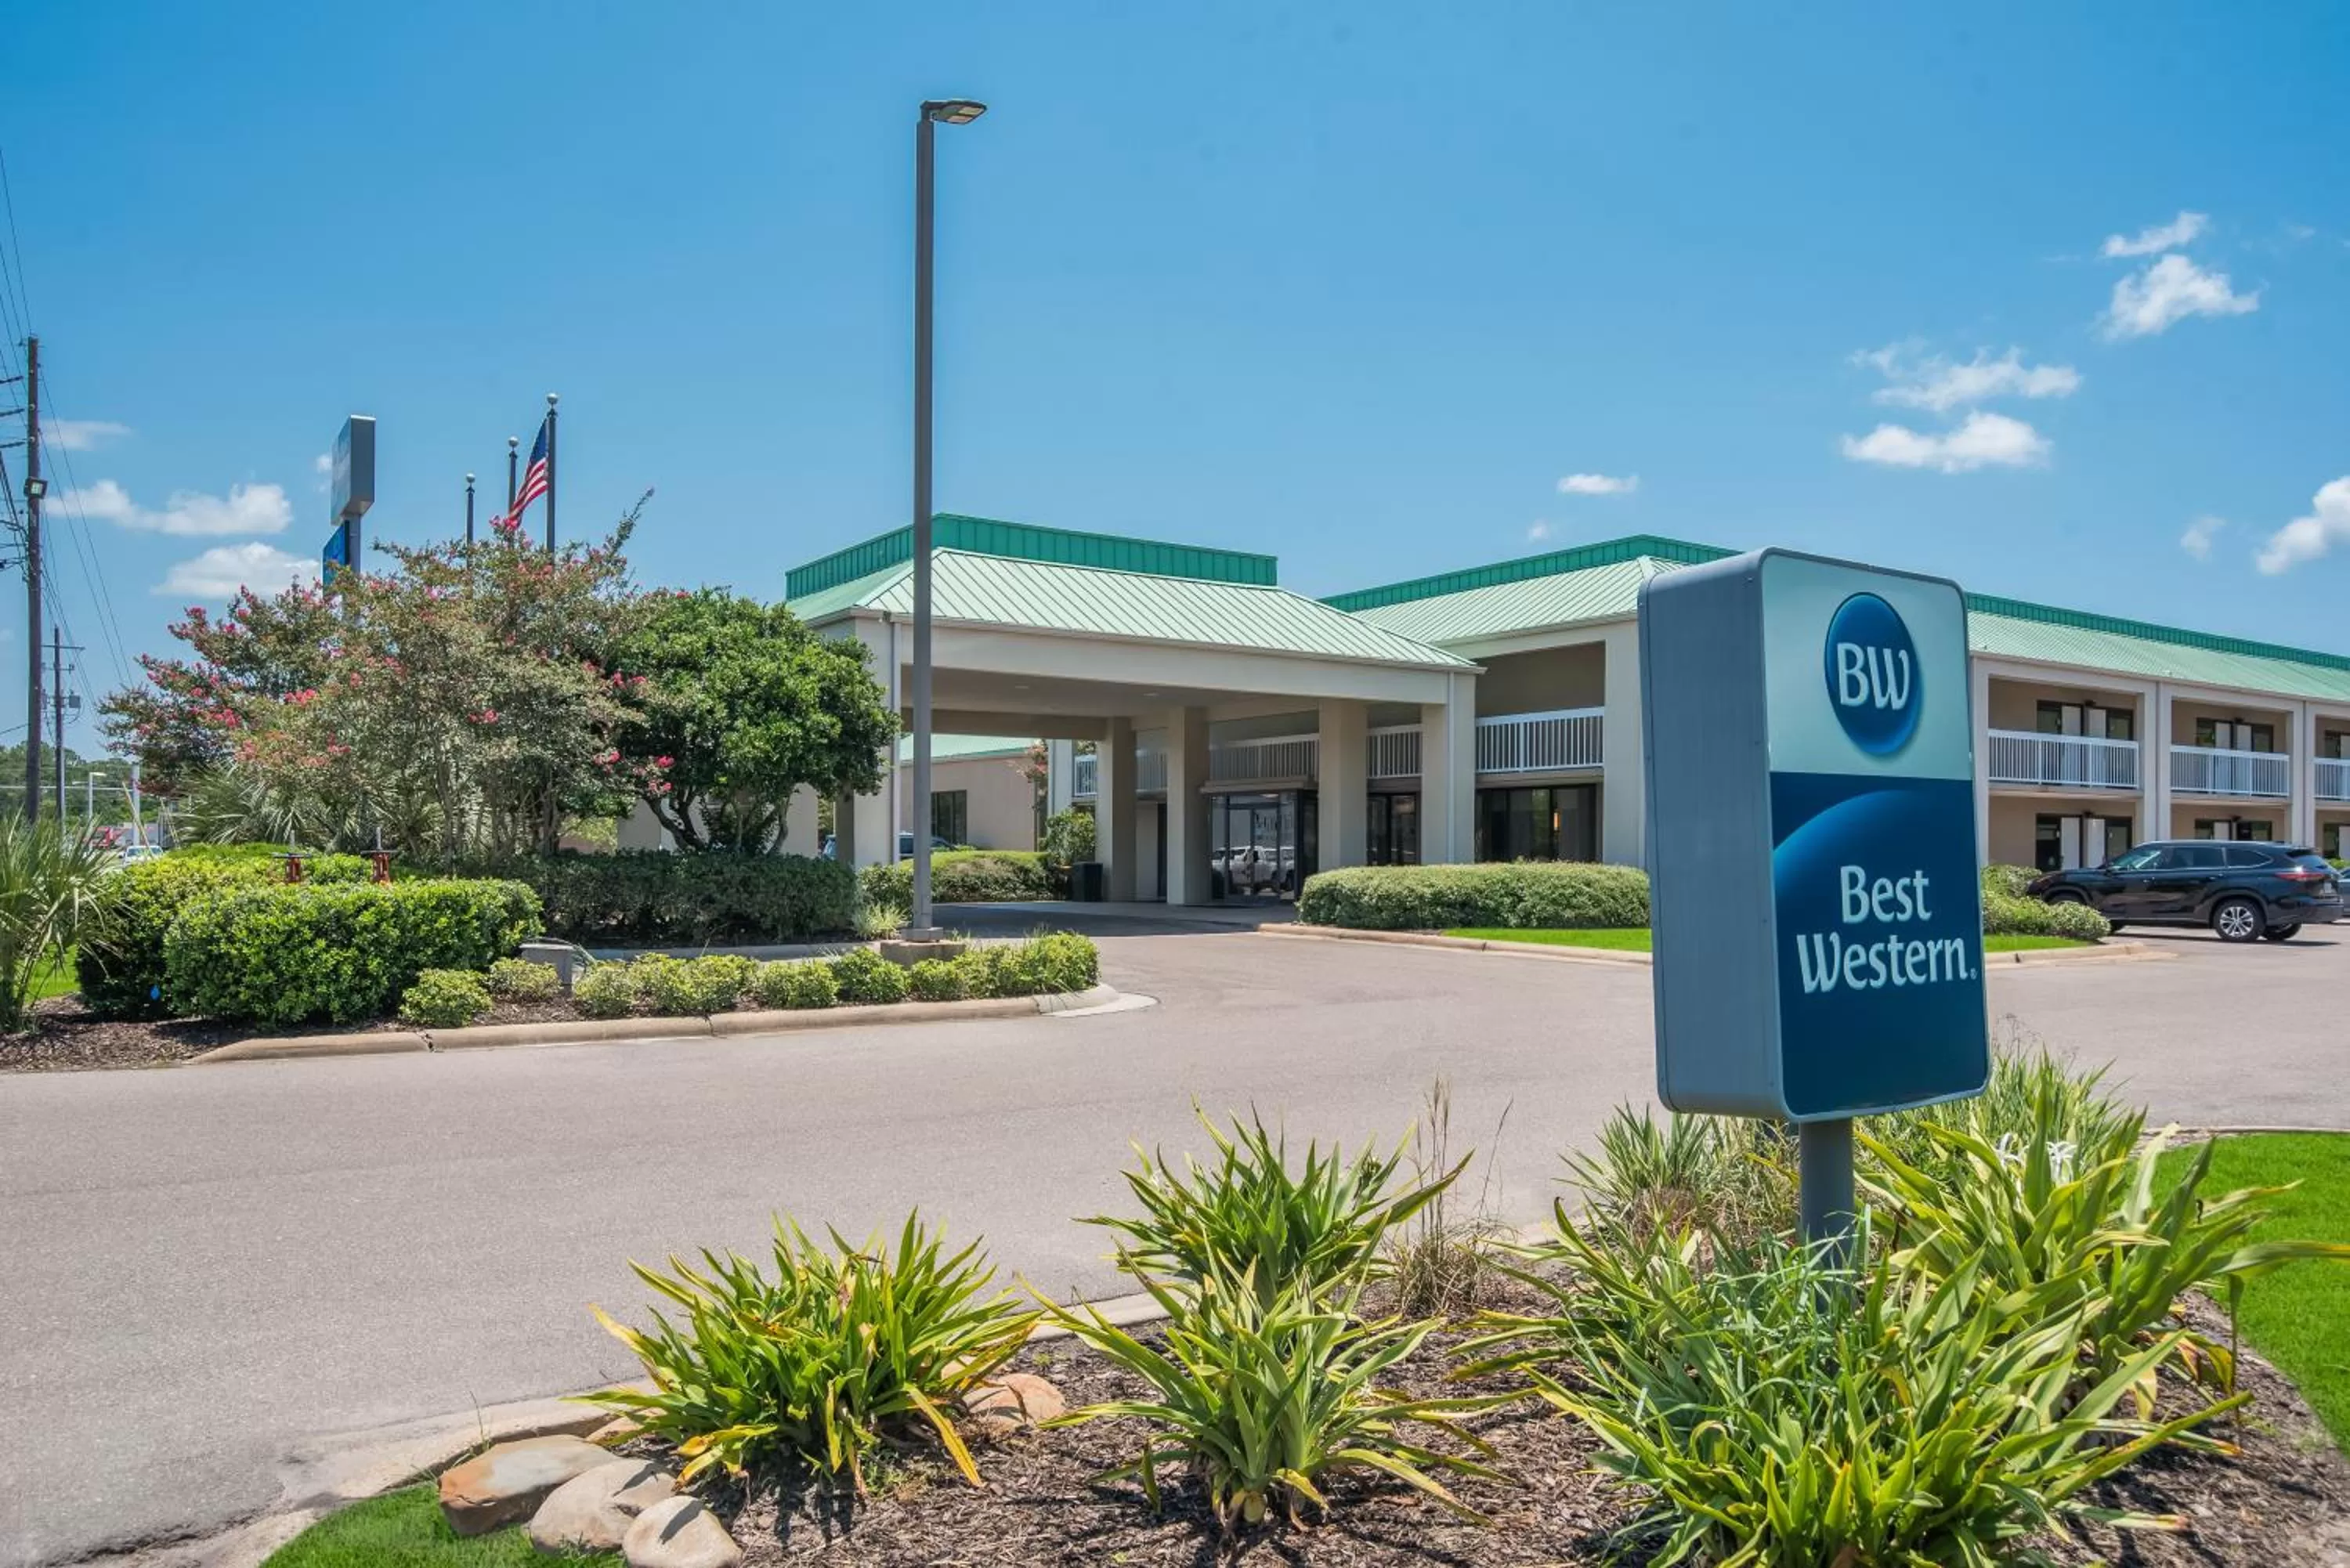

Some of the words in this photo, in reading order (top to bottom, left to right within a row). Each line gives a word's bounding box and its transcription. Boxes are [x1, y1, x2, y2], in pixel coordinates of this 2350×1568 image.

[1837, 642, 1910, 710] BW
[1841, 865, 1932, 923] Best
[1796, 931, 1968, 993] Western
